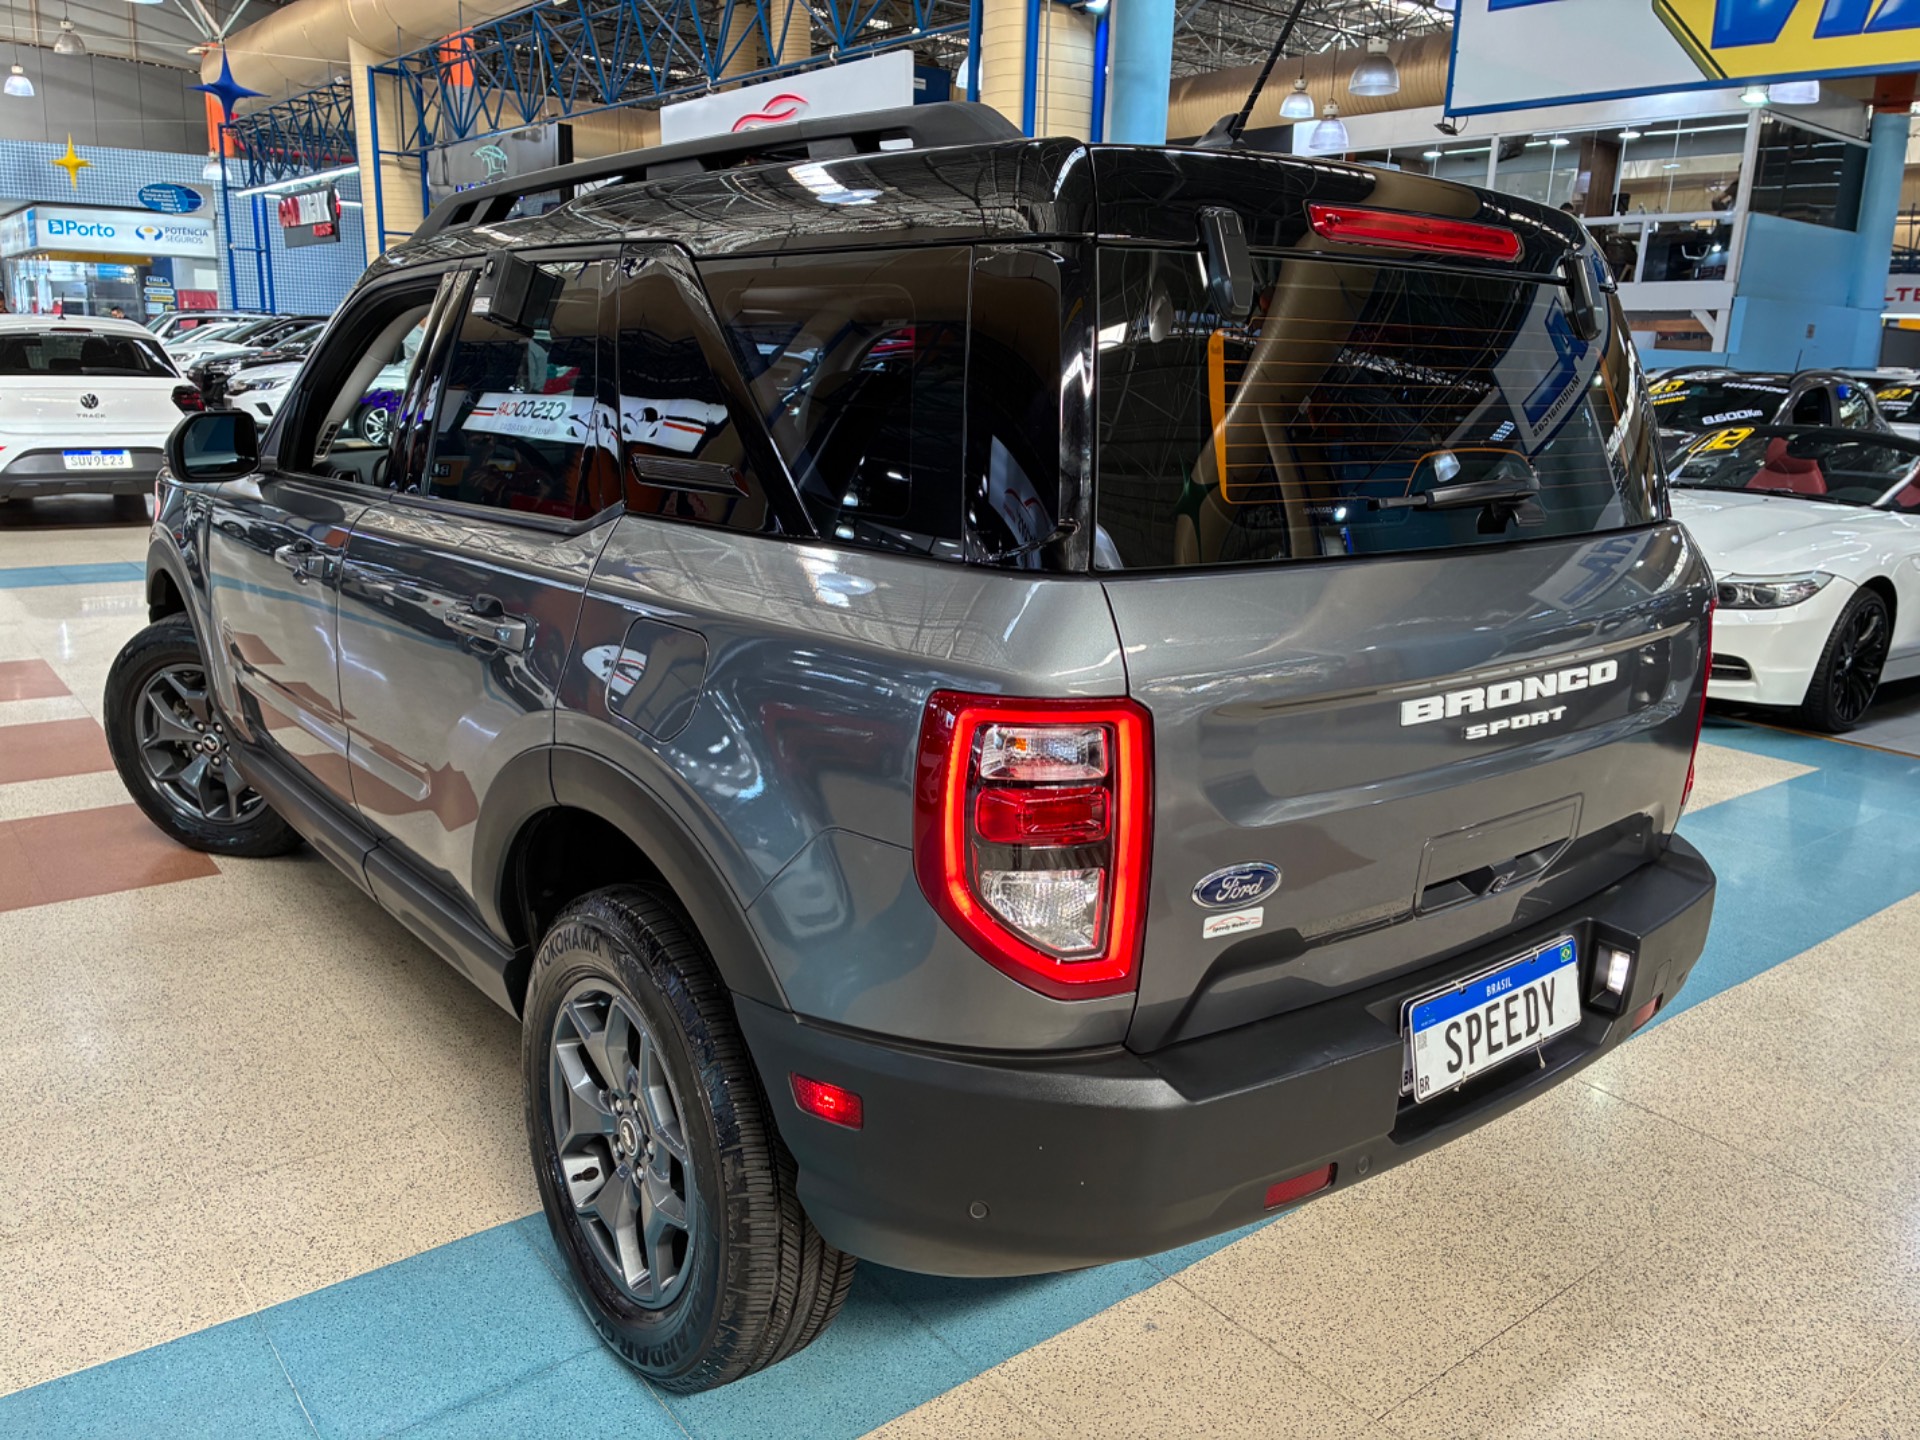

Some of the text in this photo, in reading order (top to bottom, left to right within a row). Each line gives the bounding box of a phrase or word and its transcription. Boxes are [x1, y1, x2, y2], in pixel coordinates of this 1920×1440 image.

[66, 220, 115, 238] Porto
[165, 235, 204, 244] SEGUROS
[1401, 660, 1618, 726] BRONCO
[1463, 705, 1567, 740] SPORT
[1216, 873, 1264, 902] Ford
[538, 926, 602, 970] YOKOHAMA
[1486, 977, 1513, 997] BRASIL
[1445, 977, 1555, 1074] SPEEDY
[1419, 1075, 1431, 1095] BR
